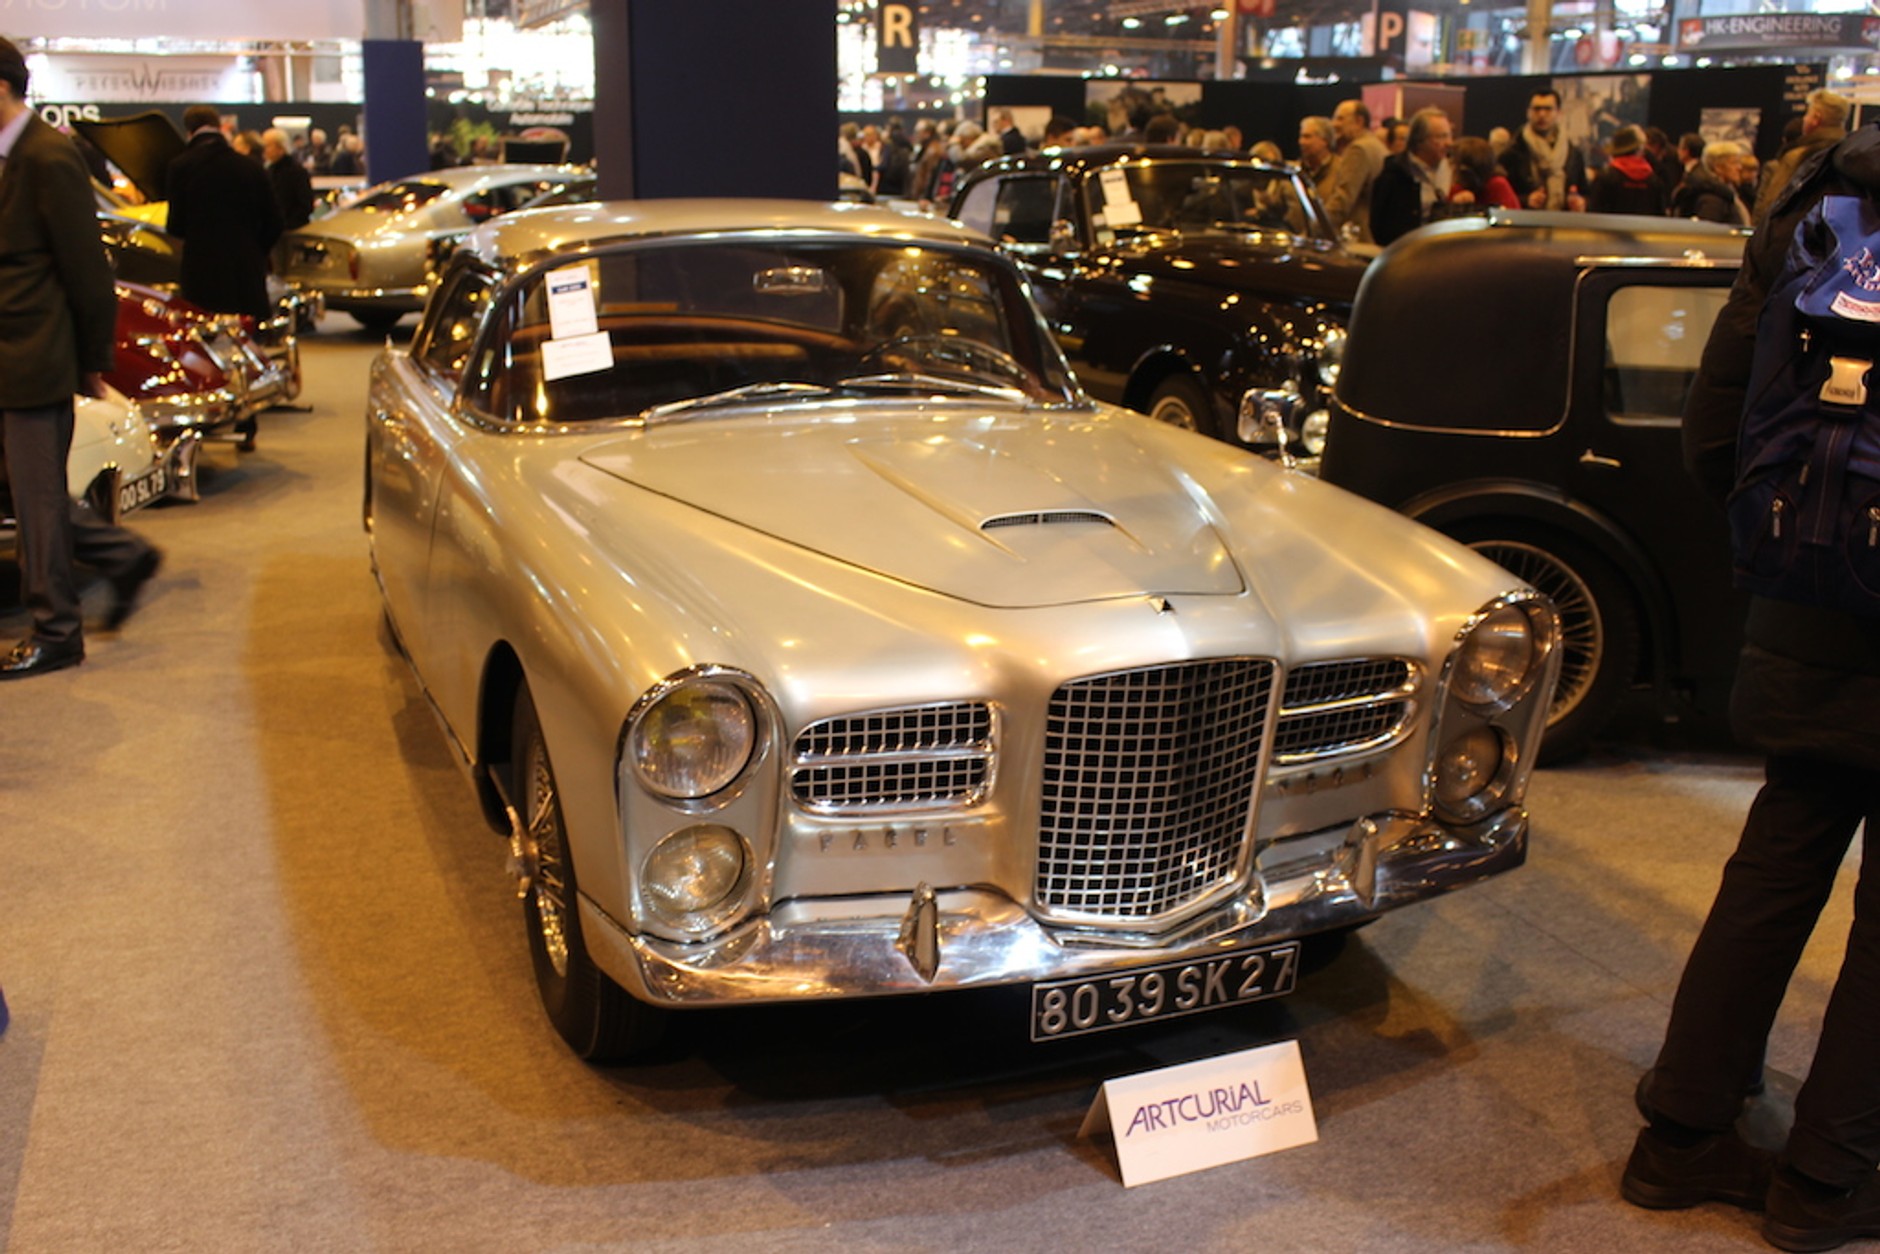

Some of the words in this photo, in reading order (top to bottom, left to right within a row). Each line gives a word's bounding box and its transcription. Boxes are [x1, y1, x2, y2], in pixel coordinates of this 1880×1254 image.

[884, 4, 912, 48] R
[1380, 12, 1403, 50] P
[1175, 959, 1232, 1009] SK
[1238, 949, 1295, 998] 27
[1206, 1100, 1304, 1133] MOTORCARS
